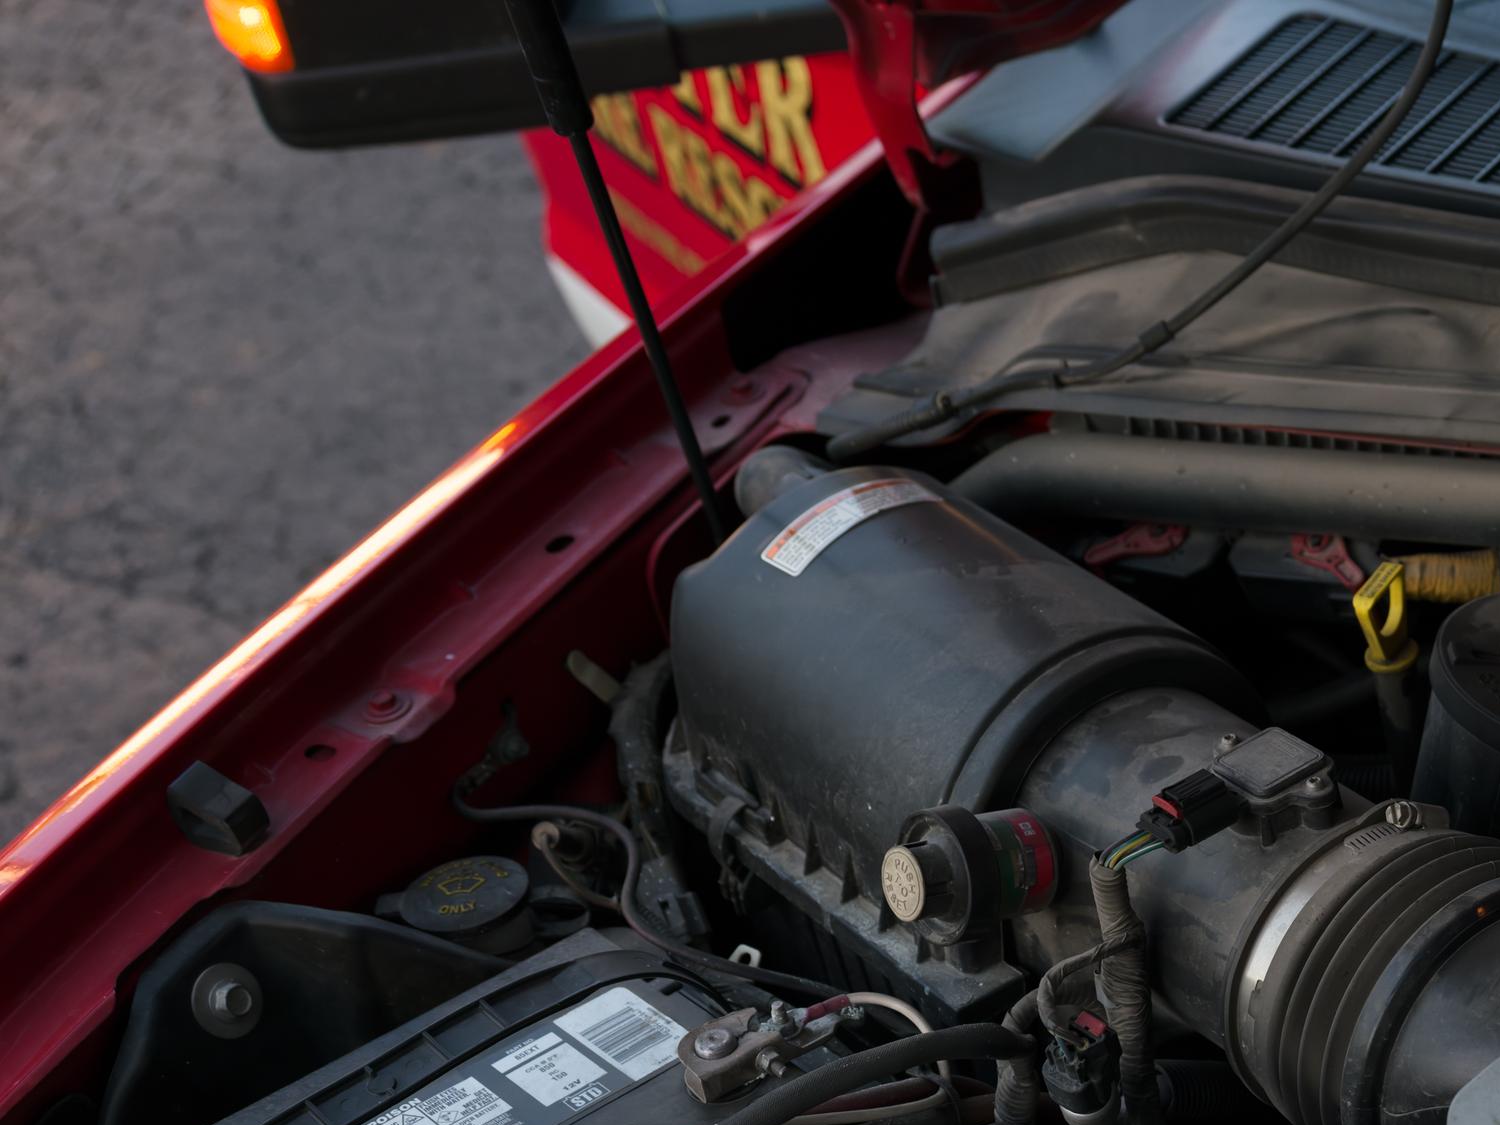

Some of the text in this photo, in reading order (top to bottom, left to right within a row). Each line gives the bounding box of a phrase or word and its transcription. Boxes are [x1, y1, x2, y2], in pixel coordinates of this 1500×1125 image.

[671, 55, 828, 190] ER
[438, 900, 476, 915] ONLY
[562, 1078, 582, 1091] 12V
[569, 1086, 603, 1107] STD
